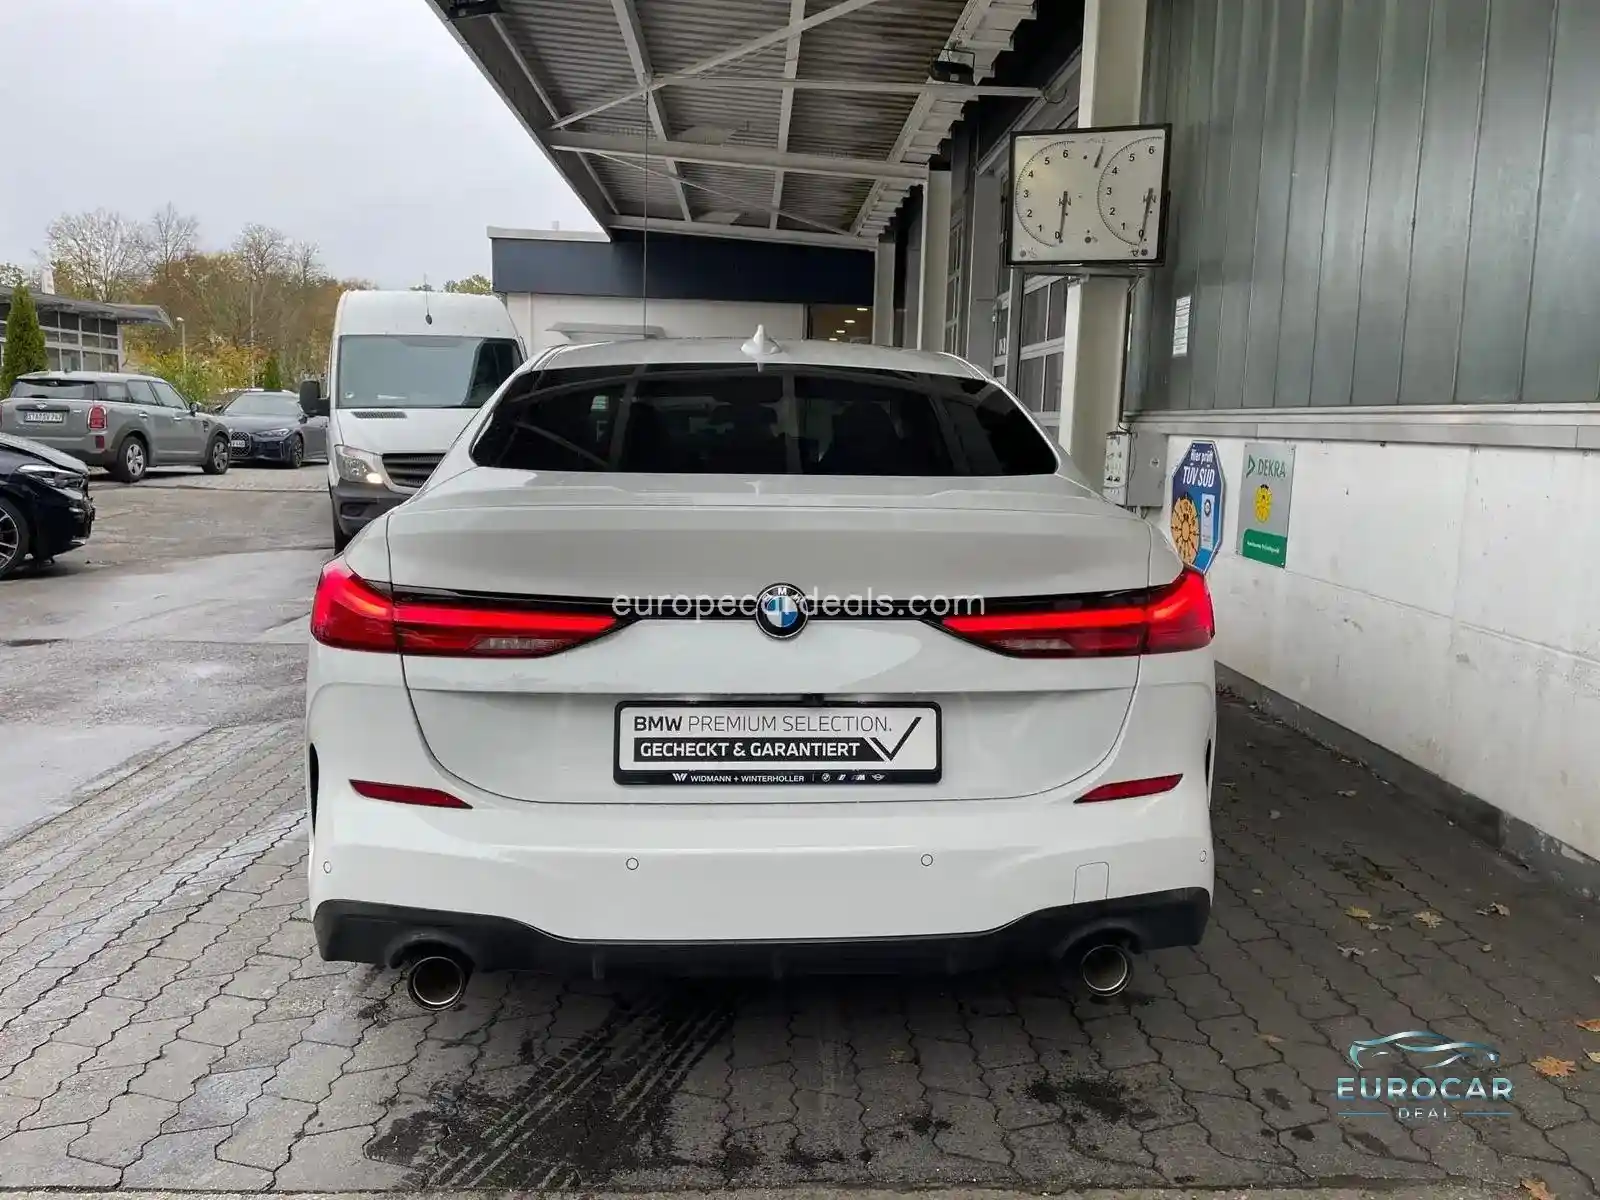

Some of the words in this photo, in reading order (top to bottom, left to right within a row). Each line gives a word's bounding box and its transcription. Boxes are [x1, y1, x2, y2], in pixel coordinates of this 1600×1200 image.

[1062, 149, 1069, 158] 6
[1149, 145, 1155, 154] 6
[1044, 156, 1050, 165] 5
[1129, 153, 1136, 162] 5
[1028, 170, 1034, 178] 4
[1111, 166, 1118, 175] 4
[1023, 189, 1030, 198] 3
[1106, 187, 1113, 195] 3
[1026, 209, 1033, 218] 2
[1109, 207, 1116, 216] 2
[1037, 224, 1043, 232] 1
[1121, 222, 1126, 231] 1
[1257, 457, 1287, 479] DEKRA
[1182, 462, 1199, 485] TÜV
[1199, 464, 1216, 488] SÜD
[634, 715, 682, 731] BMW
[688, 715, 777, 732] PREMIUM
[783, 715, 893, 732] SELECTION.
[640, 742, 730, 757] GECHECKT
[733, 742, 748, 757] &
[750, 742, 860, 757] GARANTIERT
[690, 774, 732, 783] WIDMANN
[741, 774, 805, 783] WINTERHOLLER
